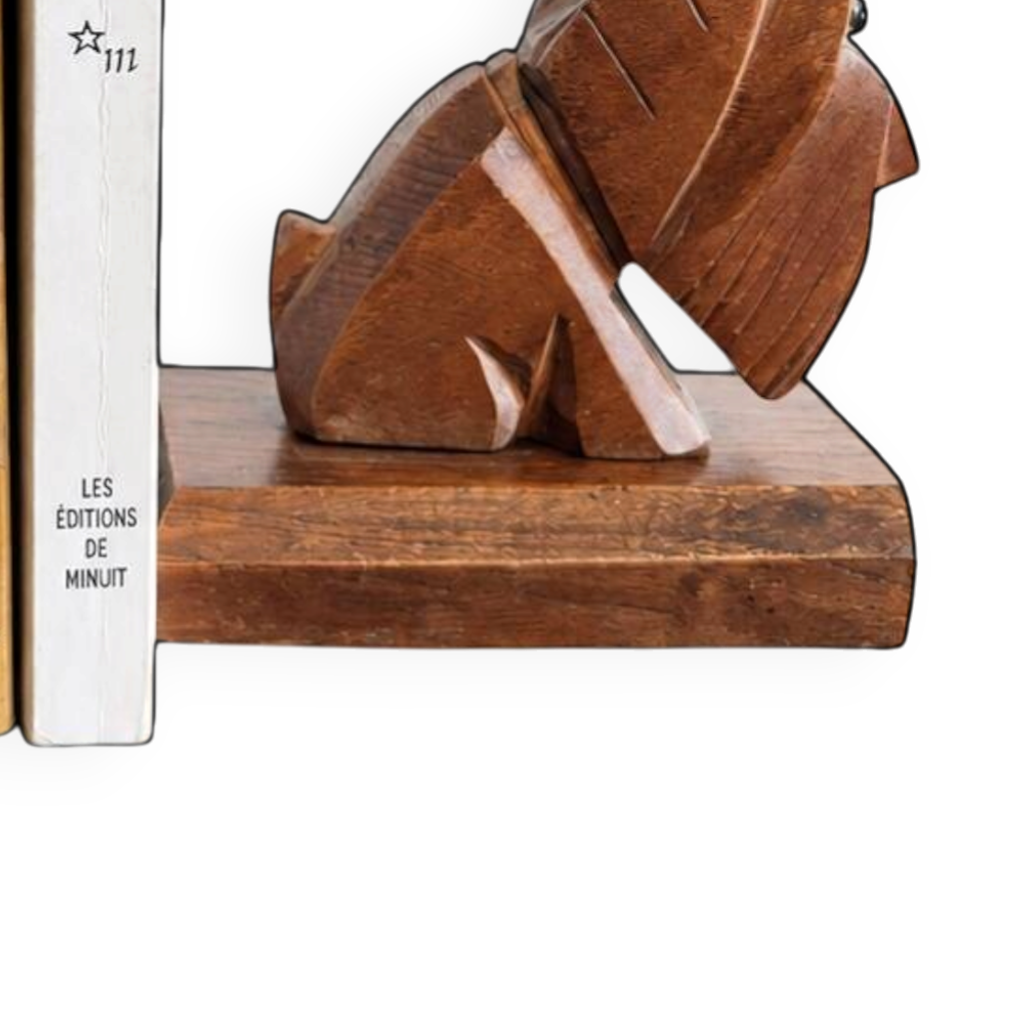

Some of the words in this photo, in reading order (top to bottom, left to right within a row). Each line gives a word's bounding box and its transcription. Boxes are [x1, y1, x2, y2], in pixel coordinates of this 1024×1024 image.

[81, 477, 114, 499] LES
[55, 503, 138, 530] ÉDITIONS
[85, 537, 108, 559] DE
[65, 567, 128, 590] MINUIT
